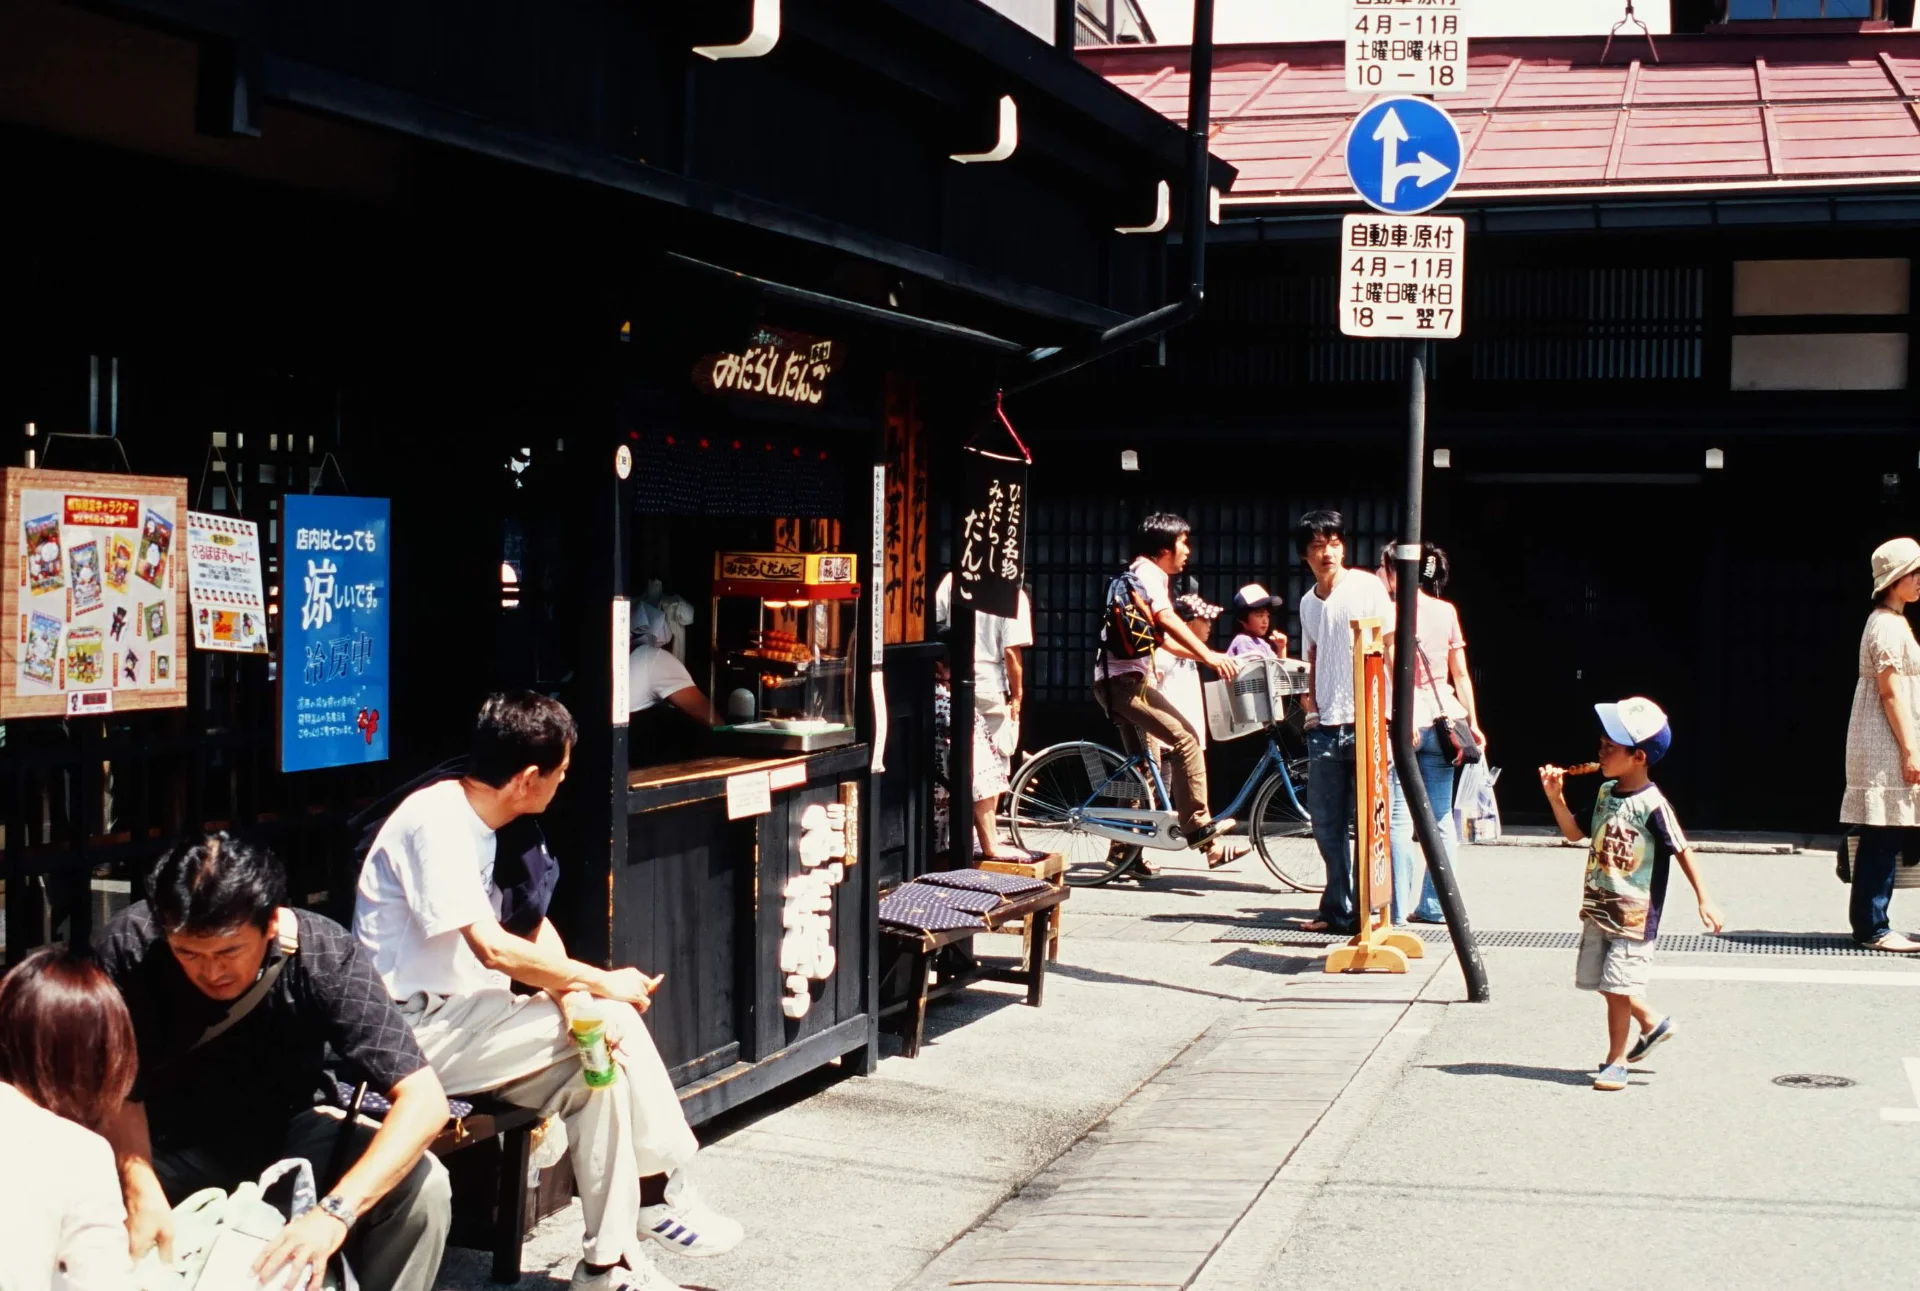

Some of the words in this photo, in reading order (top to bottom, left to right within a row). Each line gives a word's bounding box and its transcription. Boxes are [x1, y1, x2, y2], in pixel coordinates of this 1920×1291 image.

[296, 527, 376, 552] 店内はとっても
[960, 508, 986, 600] だんご
[988, 479, 1004, 573] みだらし
[1001, 483, 1021, 580] ひだの名物
[301, 557, 378, 631] 涼しいです。
[304, 631, 373, 687] 冷房中
